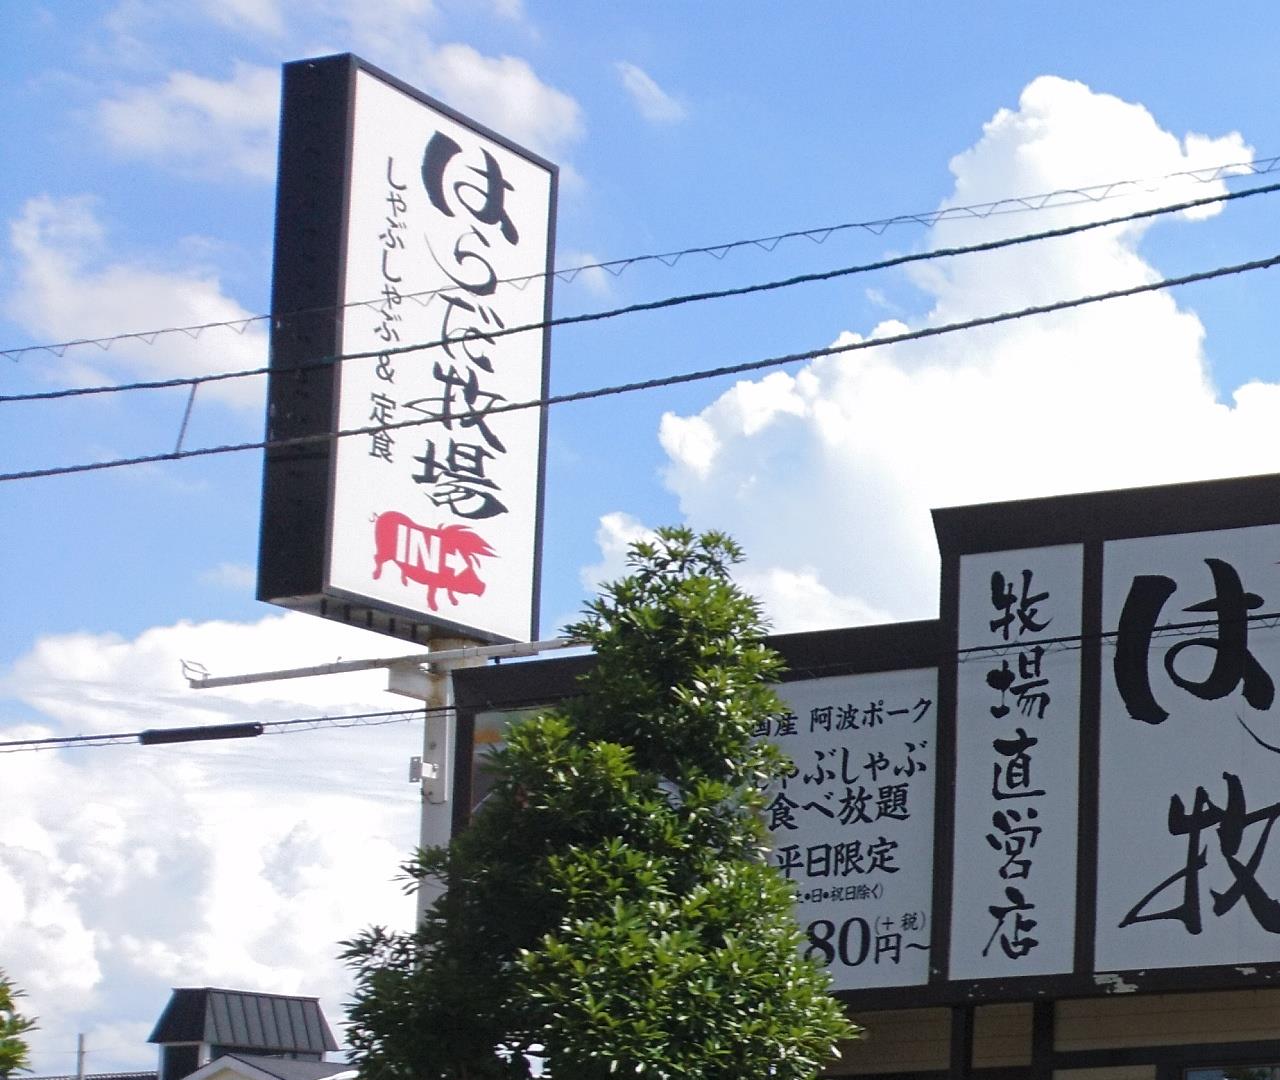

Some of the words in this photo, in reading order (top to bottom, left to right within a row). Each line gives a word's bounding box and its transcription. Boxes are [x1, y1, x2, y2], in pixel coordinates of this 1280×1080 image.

[373, 156, 408, 342] しゃぶしゃぶ
[401, 130, 520, 519] はらだ牧場
[397, 524, 441, 572] IN
[810, 699, 932, 733] 阿波ポーク
[752, 740, 928, 792] ゃぶしゃぶ
[982, 568, 1050, 960] 牧場直営店
[766, 783, 911, 832] 食べ放題
[776, 837, 900, 879] 平日限定
